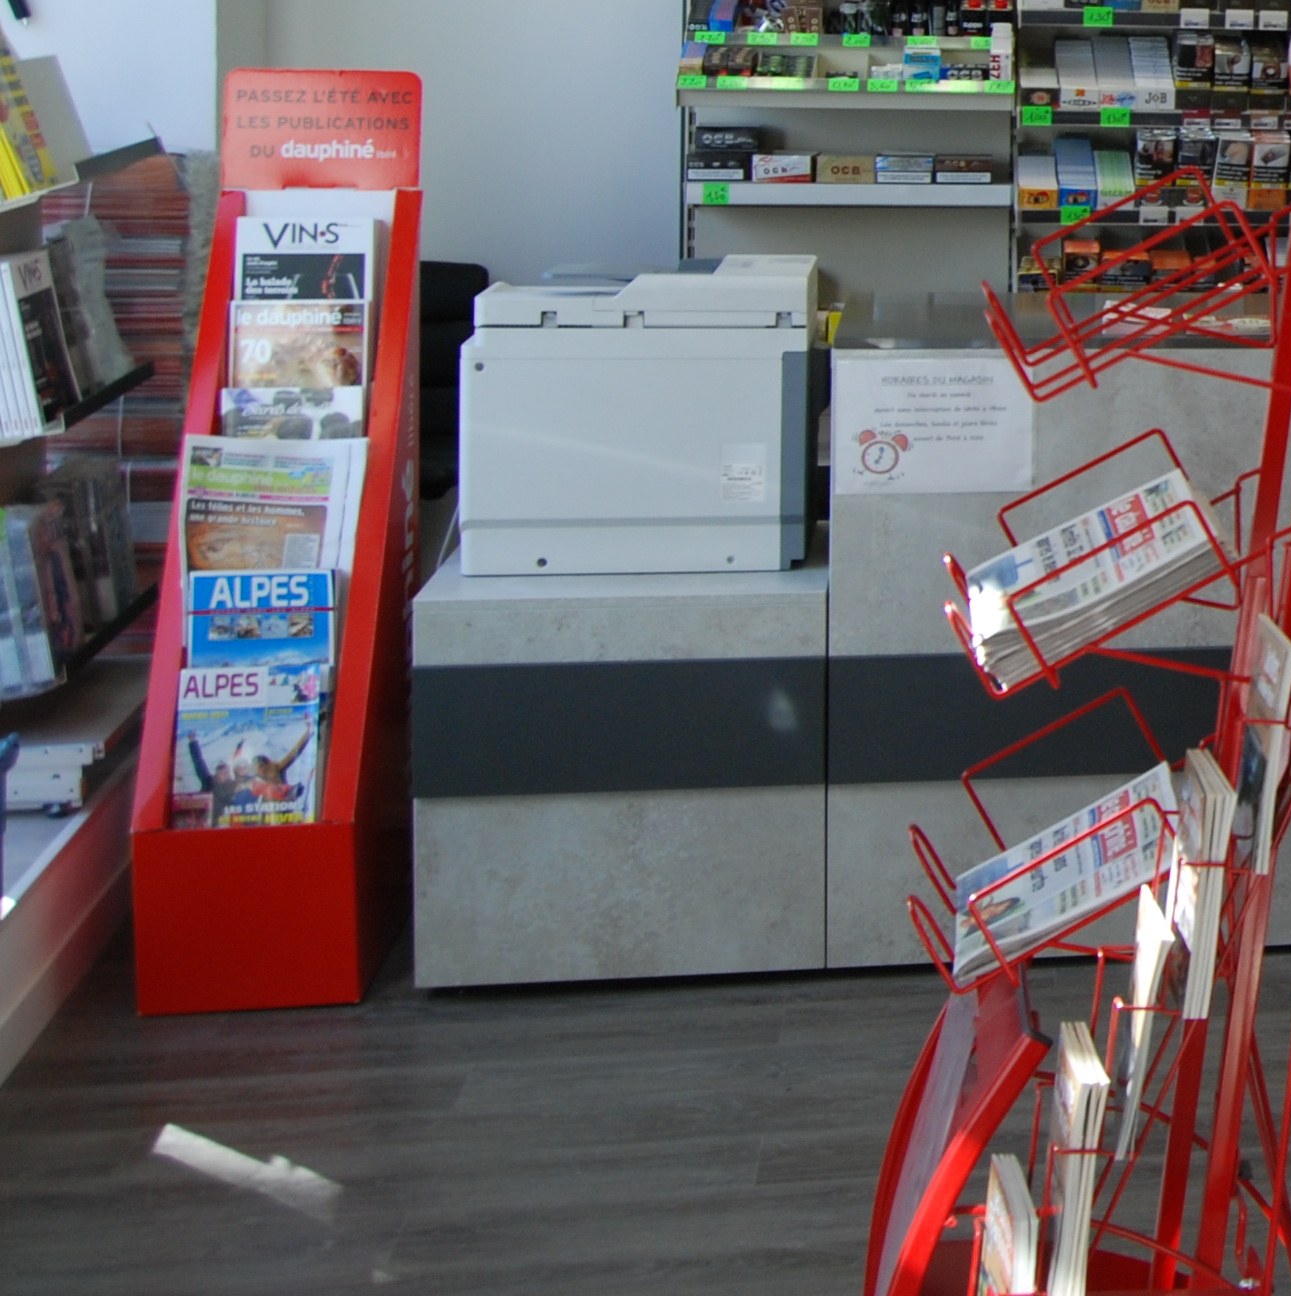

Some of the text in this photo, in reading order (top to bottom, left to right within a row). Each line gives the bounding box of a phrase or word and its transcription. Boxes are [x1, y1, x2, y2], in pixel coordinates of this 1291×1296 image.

[237, 87, 412, 104] PASSEZ L'ÉTÉ AVEC
[237, 116, 410, 130] LES PUBLICATIONS
[250, 140, 375, 162] DU dauphiné
[830, 165, 861, 175] OCB
[237, 306, 342, 328] le dauphiné
[239, 338, 272, 364] 70
[882, 376, 994, 385] HORAIRES DU MAGASIN
[205, 470, 273, 488] dauphiné
[207, 513, 238, 525] grande
[240, 515, 279, 526] histoire
[209, 574, 309, 609] ALPES
[182, 672, 260, 700] ALPES
